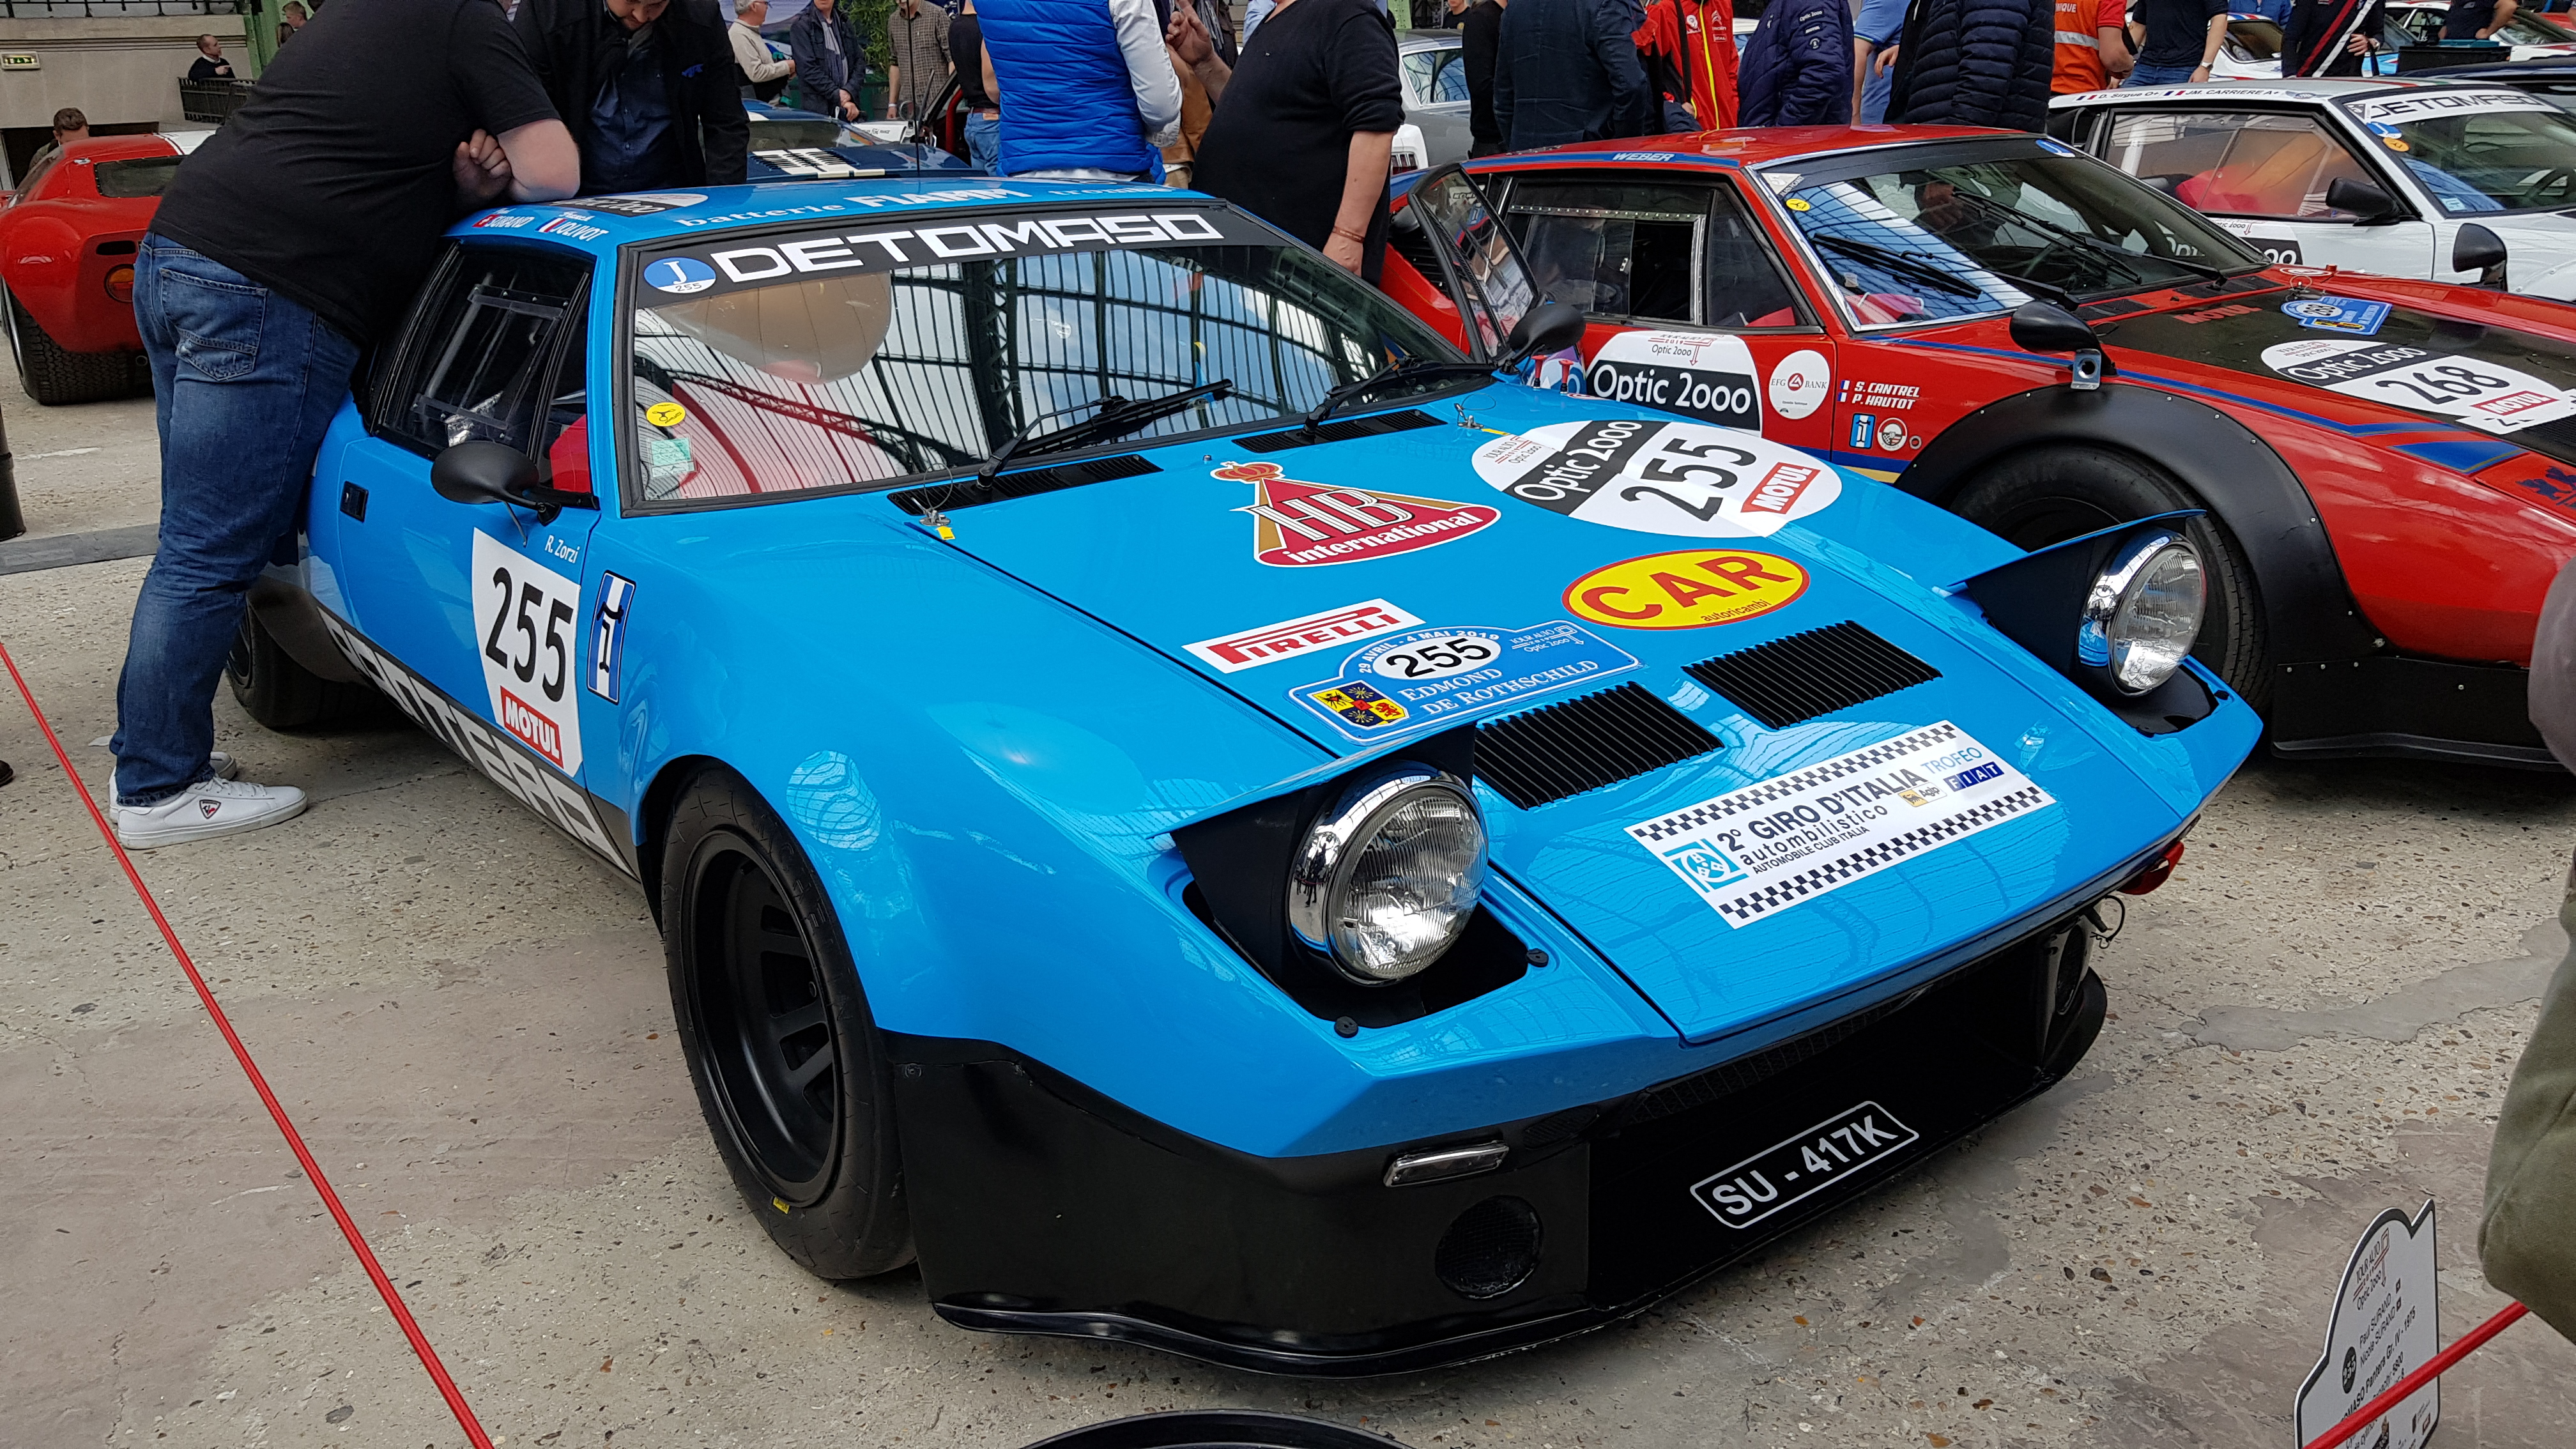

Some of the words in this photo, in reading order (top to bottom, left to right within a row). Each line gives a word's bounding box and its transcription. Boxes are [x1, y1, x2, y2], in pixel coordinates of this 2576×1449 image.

[1613, 152, 1675, 162] WEBER
[673, 204, 846, 227] batterie
[843, 188, 1032, 208] FIAMM
[549, 221, 609, 241] JOLIVOT
[710, 214, 1224, 282] DETOMASO
[663, 261, 687, 285] J
[675, 282, 702, 292] 255
[2174, 304, 2264, 324] MOTUL
[1652, 344, 1671, 356] Optic
[1673, 346, 1692, 356] 2000
[2288, 358, 2366, 379] Optic
[2348, 347, 2427, 369] 2000
[1593, 364, 1669, 404] Optic
[1675, 372, 1751, 415] 2000
[1771, 378, 1786, 387] EFG
[1805, 380, 1827, 390] BANK
[2375, 365, 2510, 405] 268
[2480, 394, 2552, 414] MOTUL
[1508, 451, 1528, 464] Optic
[1525, 445, 1542, 457] 2000
[1514, 459, 1600, 501] Optic
[1567, 421, 1643, 462] 2000
[1620, 438, 1756, 521] 255
[1751, 466, 1813, 511] MOTUL
[1247, 488, 1415, 542] HB
[545, 534, 554, 554] R.
[554, 539, 580, 564] Zorzi
[1283, 511, 1483, 564] international
[1581, 556, 1795, 620] CAR
[1701, 599, 1772, 622] autoricambi
[486, 567, 574, 702] 255
[1206, 606, 1401, 664] PIRELLI
[1362, 641, 1398, 662] AVRIL
[1422, 631, 1451, 640] MAI
[1456, 630, 1499, 641] 2019
[1510, 632, 1532, 643] TOUR
[1531, 629, 1554, 640] AUTO
[1524, 642, 1549, 653] Optic
[1549, 638, 1570, 647] 2000
[1358, 663, 1372, 674] 29
[1386, 638, 1491, 678] 255
[1397, 668, 1503, 701] EDMOND
[1421, 698, 1459, 716] DE
[1456, 660, 1598, 705] ROTHSCHILD
[317, 606, 641, 884] PANTERA
[505, 695, 560, 760] MOTUL
[1920, 747, 1982, 774] TROFEO
[1949, 764, 1998, 788] FIAT
[1748, 805, 1821, 839] GIRO
[1815, 769, 1929, 815] D'ITALIA
[1918, 786, 1940, 797] Agip
[1740, 805, 1888, 866] autombilistico
[1752, 845, 1815, 875] AUTOMOBILE
[1815, 837, 1840, 850] CLUB
[1839, 826, 1871, 841] ITALIA
[1712, 1170, 1778, 1215] SU
[1784, 1171, 1800, 1181] -
[1801, 1115, 1898, 1172] 417K
[2356, 1258, 2368, 1284] TOUR
[2357, 1287, 2370, 1310] Optic
[2370, 1270, 2382, 1292] 2000
[2359, 1324, 2370, 1349] Paul
[2371, 1293, 2391, 1330] SURAND
[2360, 1341, 2375, 1367] Nicole
[2375, 1307, 2395, 1345] SURAND
[2366, 1356, 2386, 1393] Pantera
[2386, 1343, 2395, 1360] Gr.
[2395, 1328, 2400, 1346] IV
[2404, 1305, 2416, 1331] 1975
[2342, 1354, 2357, 1386] 255
